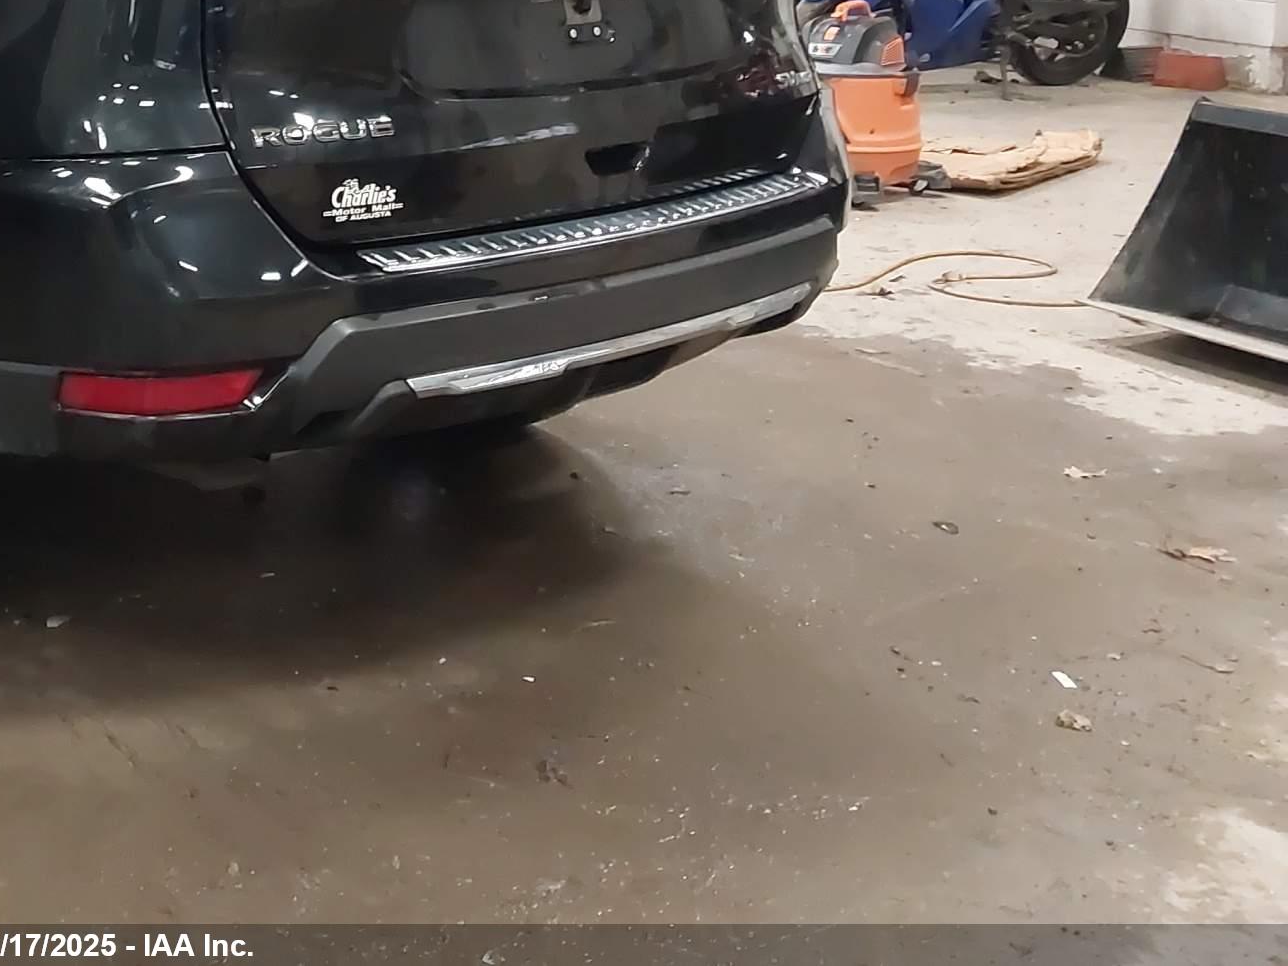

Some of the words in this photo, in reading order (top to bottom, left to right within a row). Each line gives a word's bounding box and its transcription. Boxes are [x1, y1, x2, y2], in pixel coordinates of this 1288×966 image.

[251, 116, 395, 148] ROGUE
[331, 183, 397, 208] Charlie's
[332, 207, 367, 216] Motor
[371, 202, 395, 212] Mall
[349, 211, 392, 221] AUGUSTA
